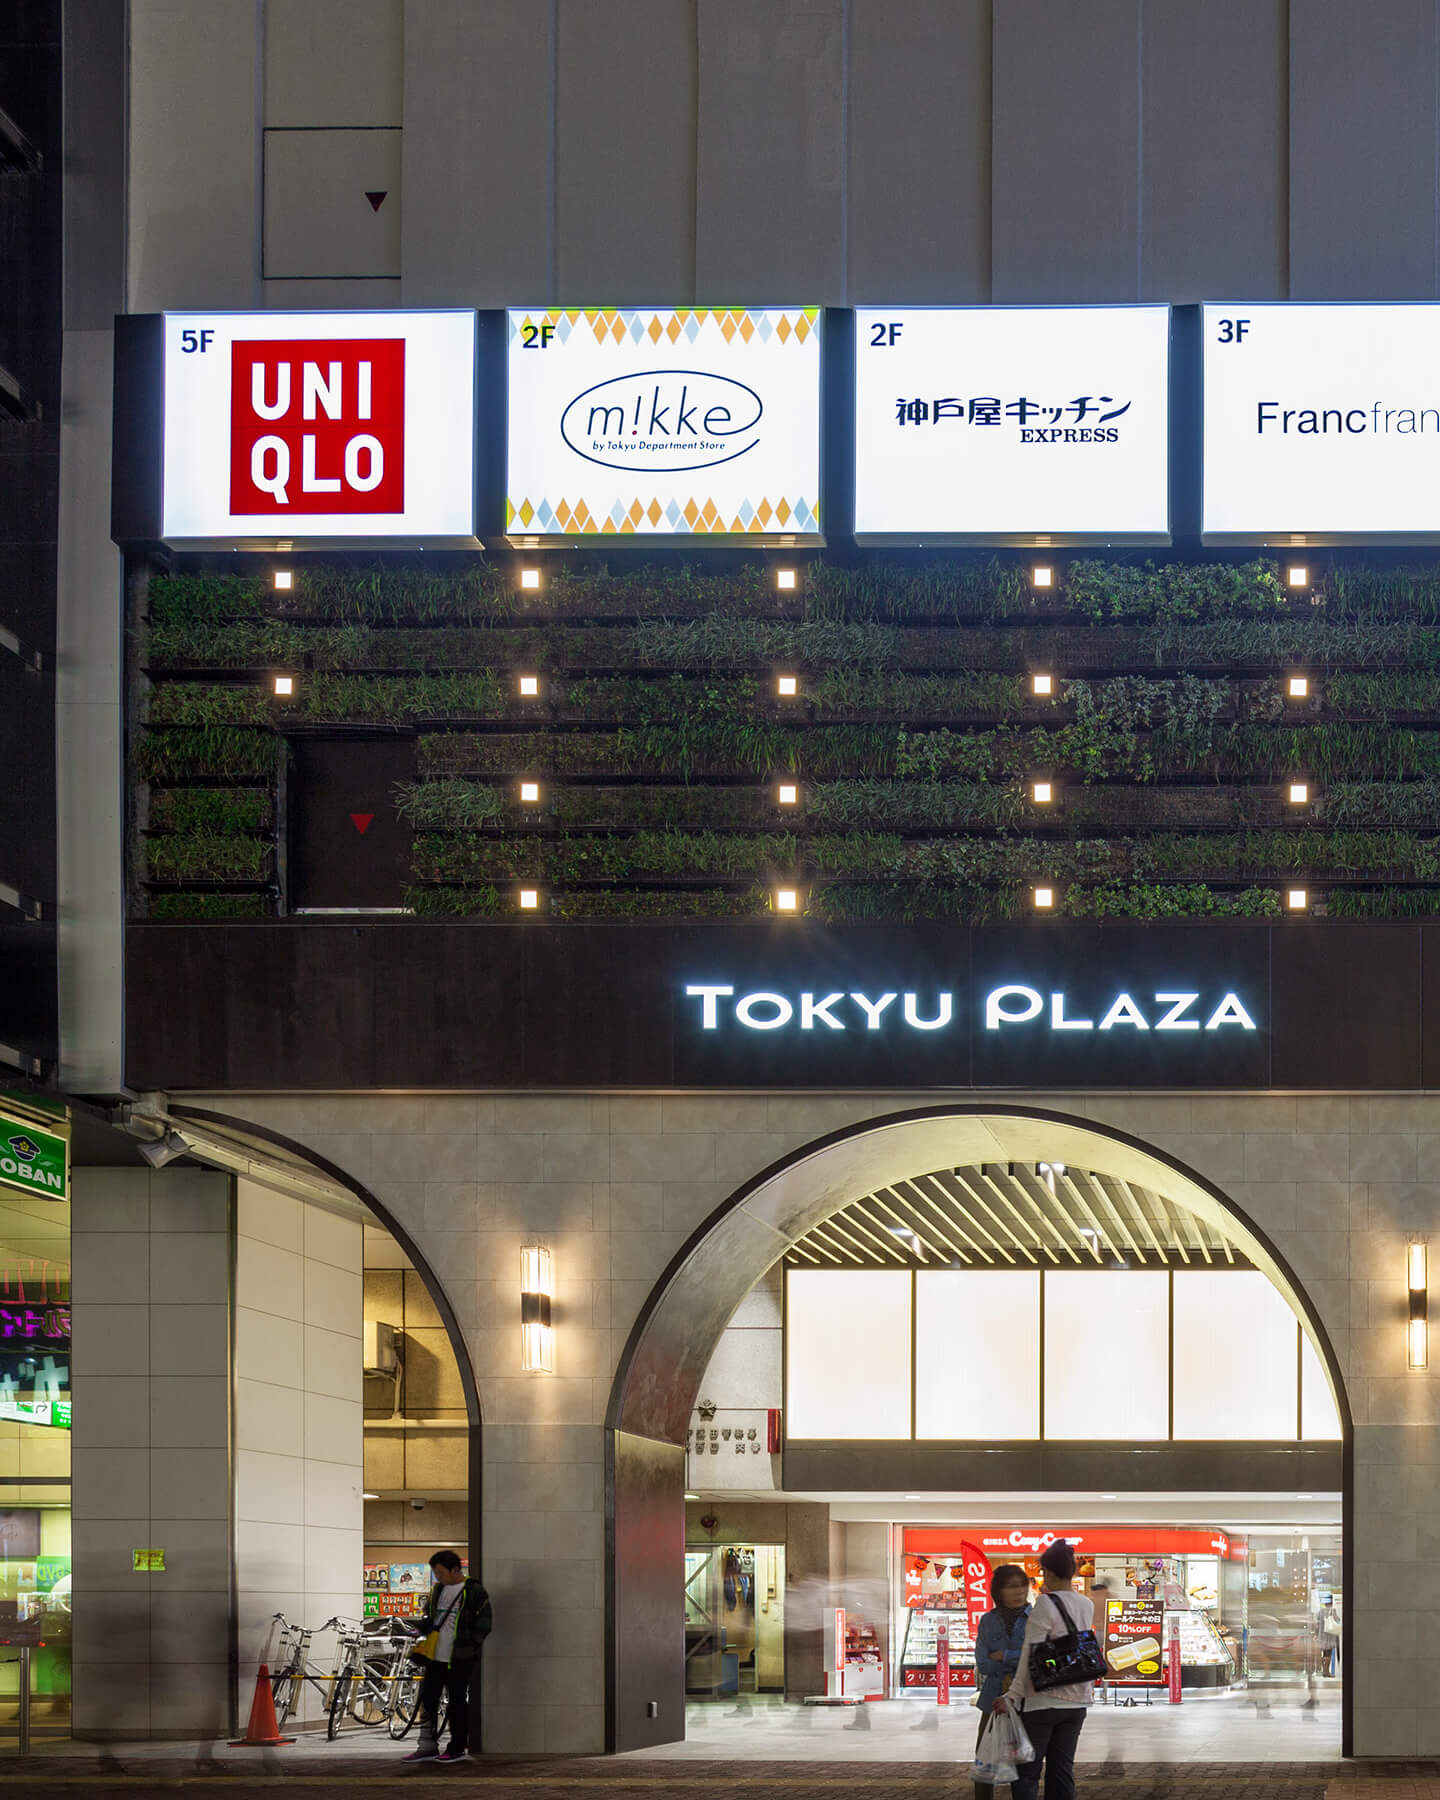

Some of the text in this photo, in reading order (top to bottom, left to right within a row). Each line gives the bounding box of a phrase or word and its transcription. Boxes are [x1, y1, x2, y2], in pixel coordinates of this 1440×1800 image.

[182, 329, 215, 354] 5F
[522, 324, 556, 349] 2F
[870, 322, 904, 347] 2F
[1217, 319, 1251, 344] 3F
[251, 361, 373, 421] UNI
[592, 440, 726, 452] by Tokyu Department Store
[1020, 427, 1120, 443] EXPRESS
[250, 434, 385, 504] QLO
[686, 985, 1257, 1030] TOKYU PLAZA
